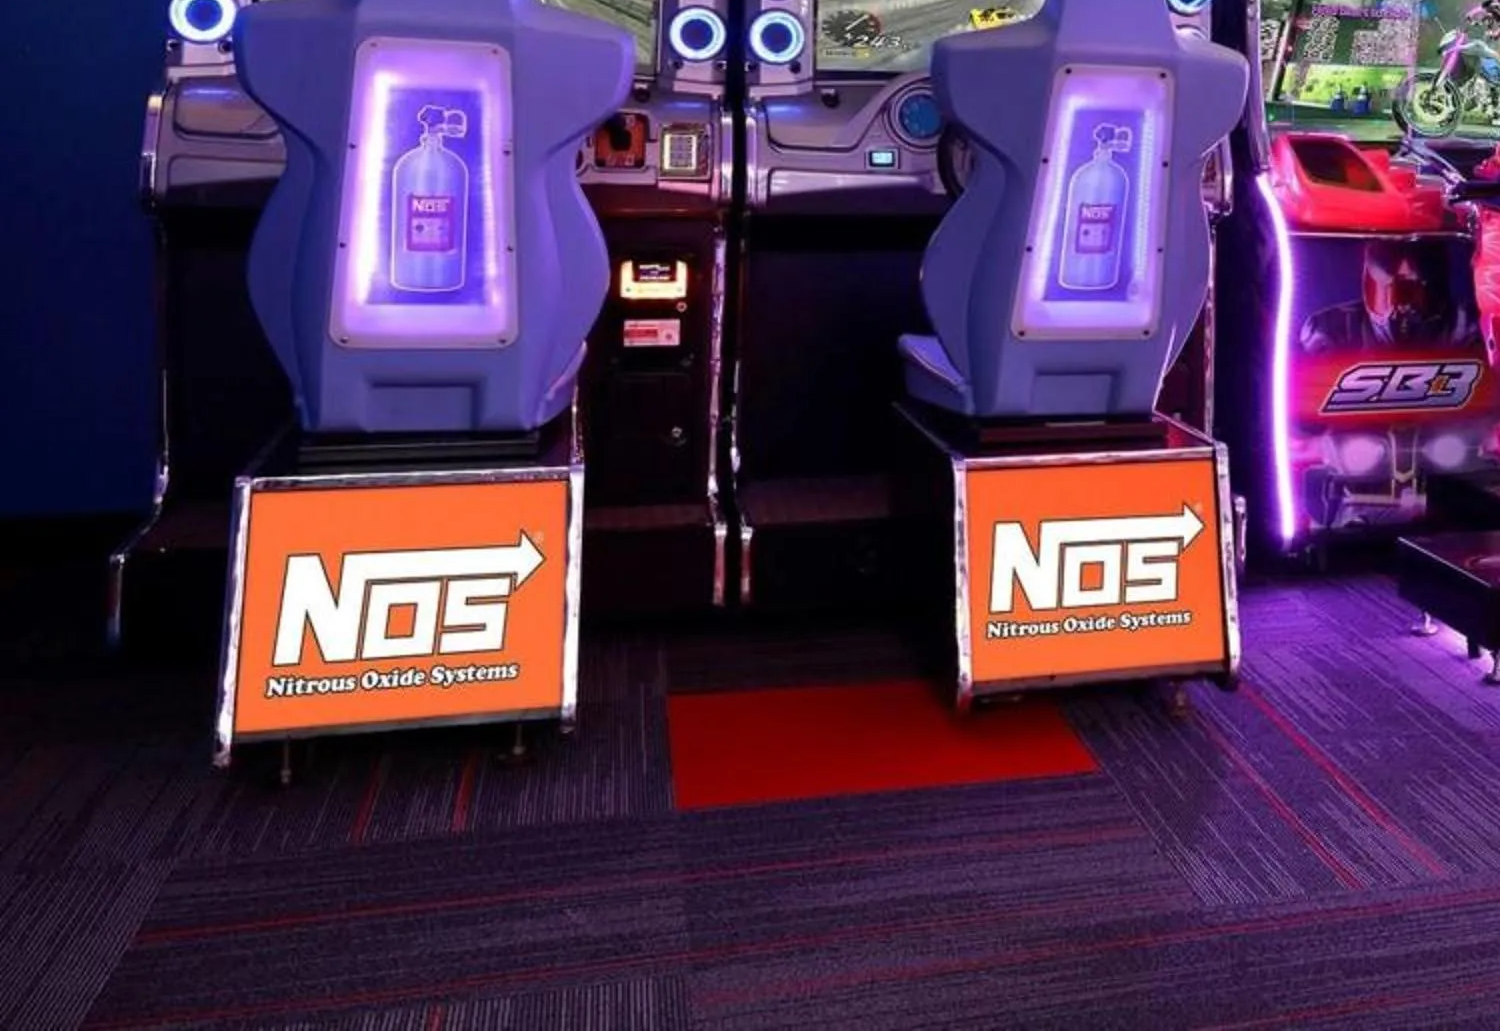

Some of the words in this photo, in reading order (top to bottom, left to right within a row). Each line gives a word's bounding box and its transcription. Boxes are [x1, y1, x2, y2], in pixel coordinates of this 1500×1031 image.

[1321, 360, 1484, 415] SB3
[989, 501, 1205, 614] NOS
[272, 529, 546, 667] NOS
[986, 620, 1060, 640] Nitrous
[1062, 616, 1117, 634] Oxide
[1119, 610, 1192, 632] Systems
[265, 675, 357, 699] Nitrous
[360, 667, 426, 692] Oxide
[430, 661, 520, 687] Systems
